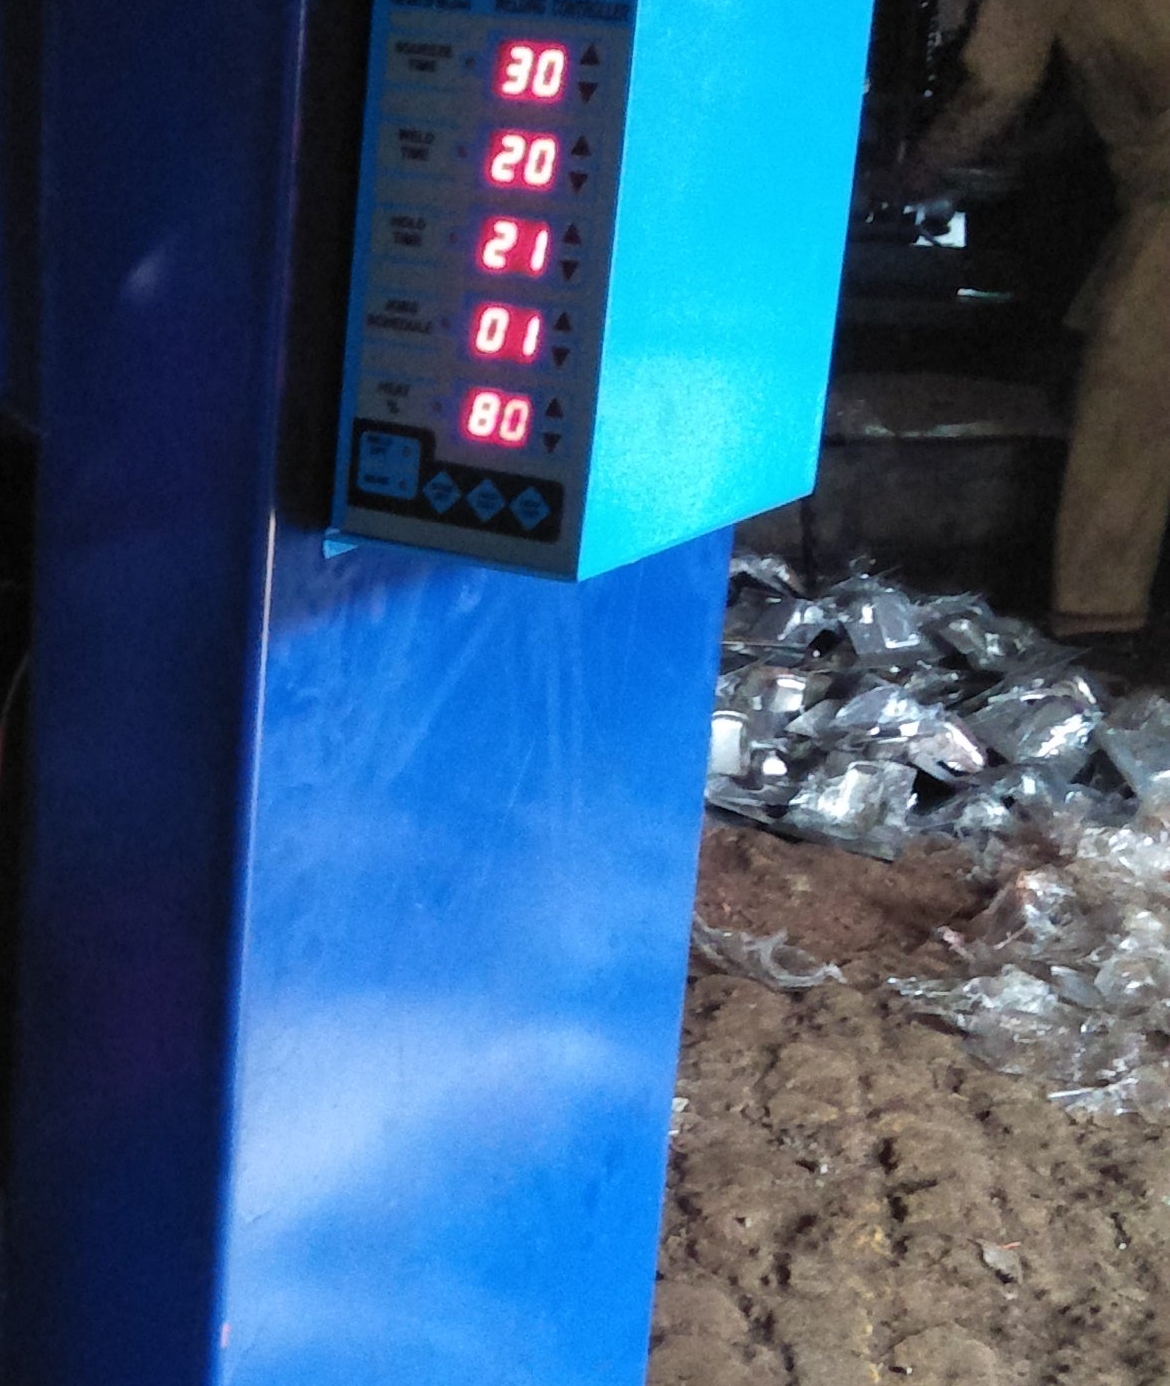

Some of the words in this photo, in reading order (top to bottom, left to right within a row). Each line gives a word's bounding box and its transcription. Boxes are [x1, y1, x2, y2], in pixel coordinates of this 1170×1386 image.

[501, 45, 565, 98] 30
[491, 134, 556, 185] 20
[483, 220, 548, 271] 21
[476, 306, 540, 356] 01
[468, 392, 529, 441] 80
